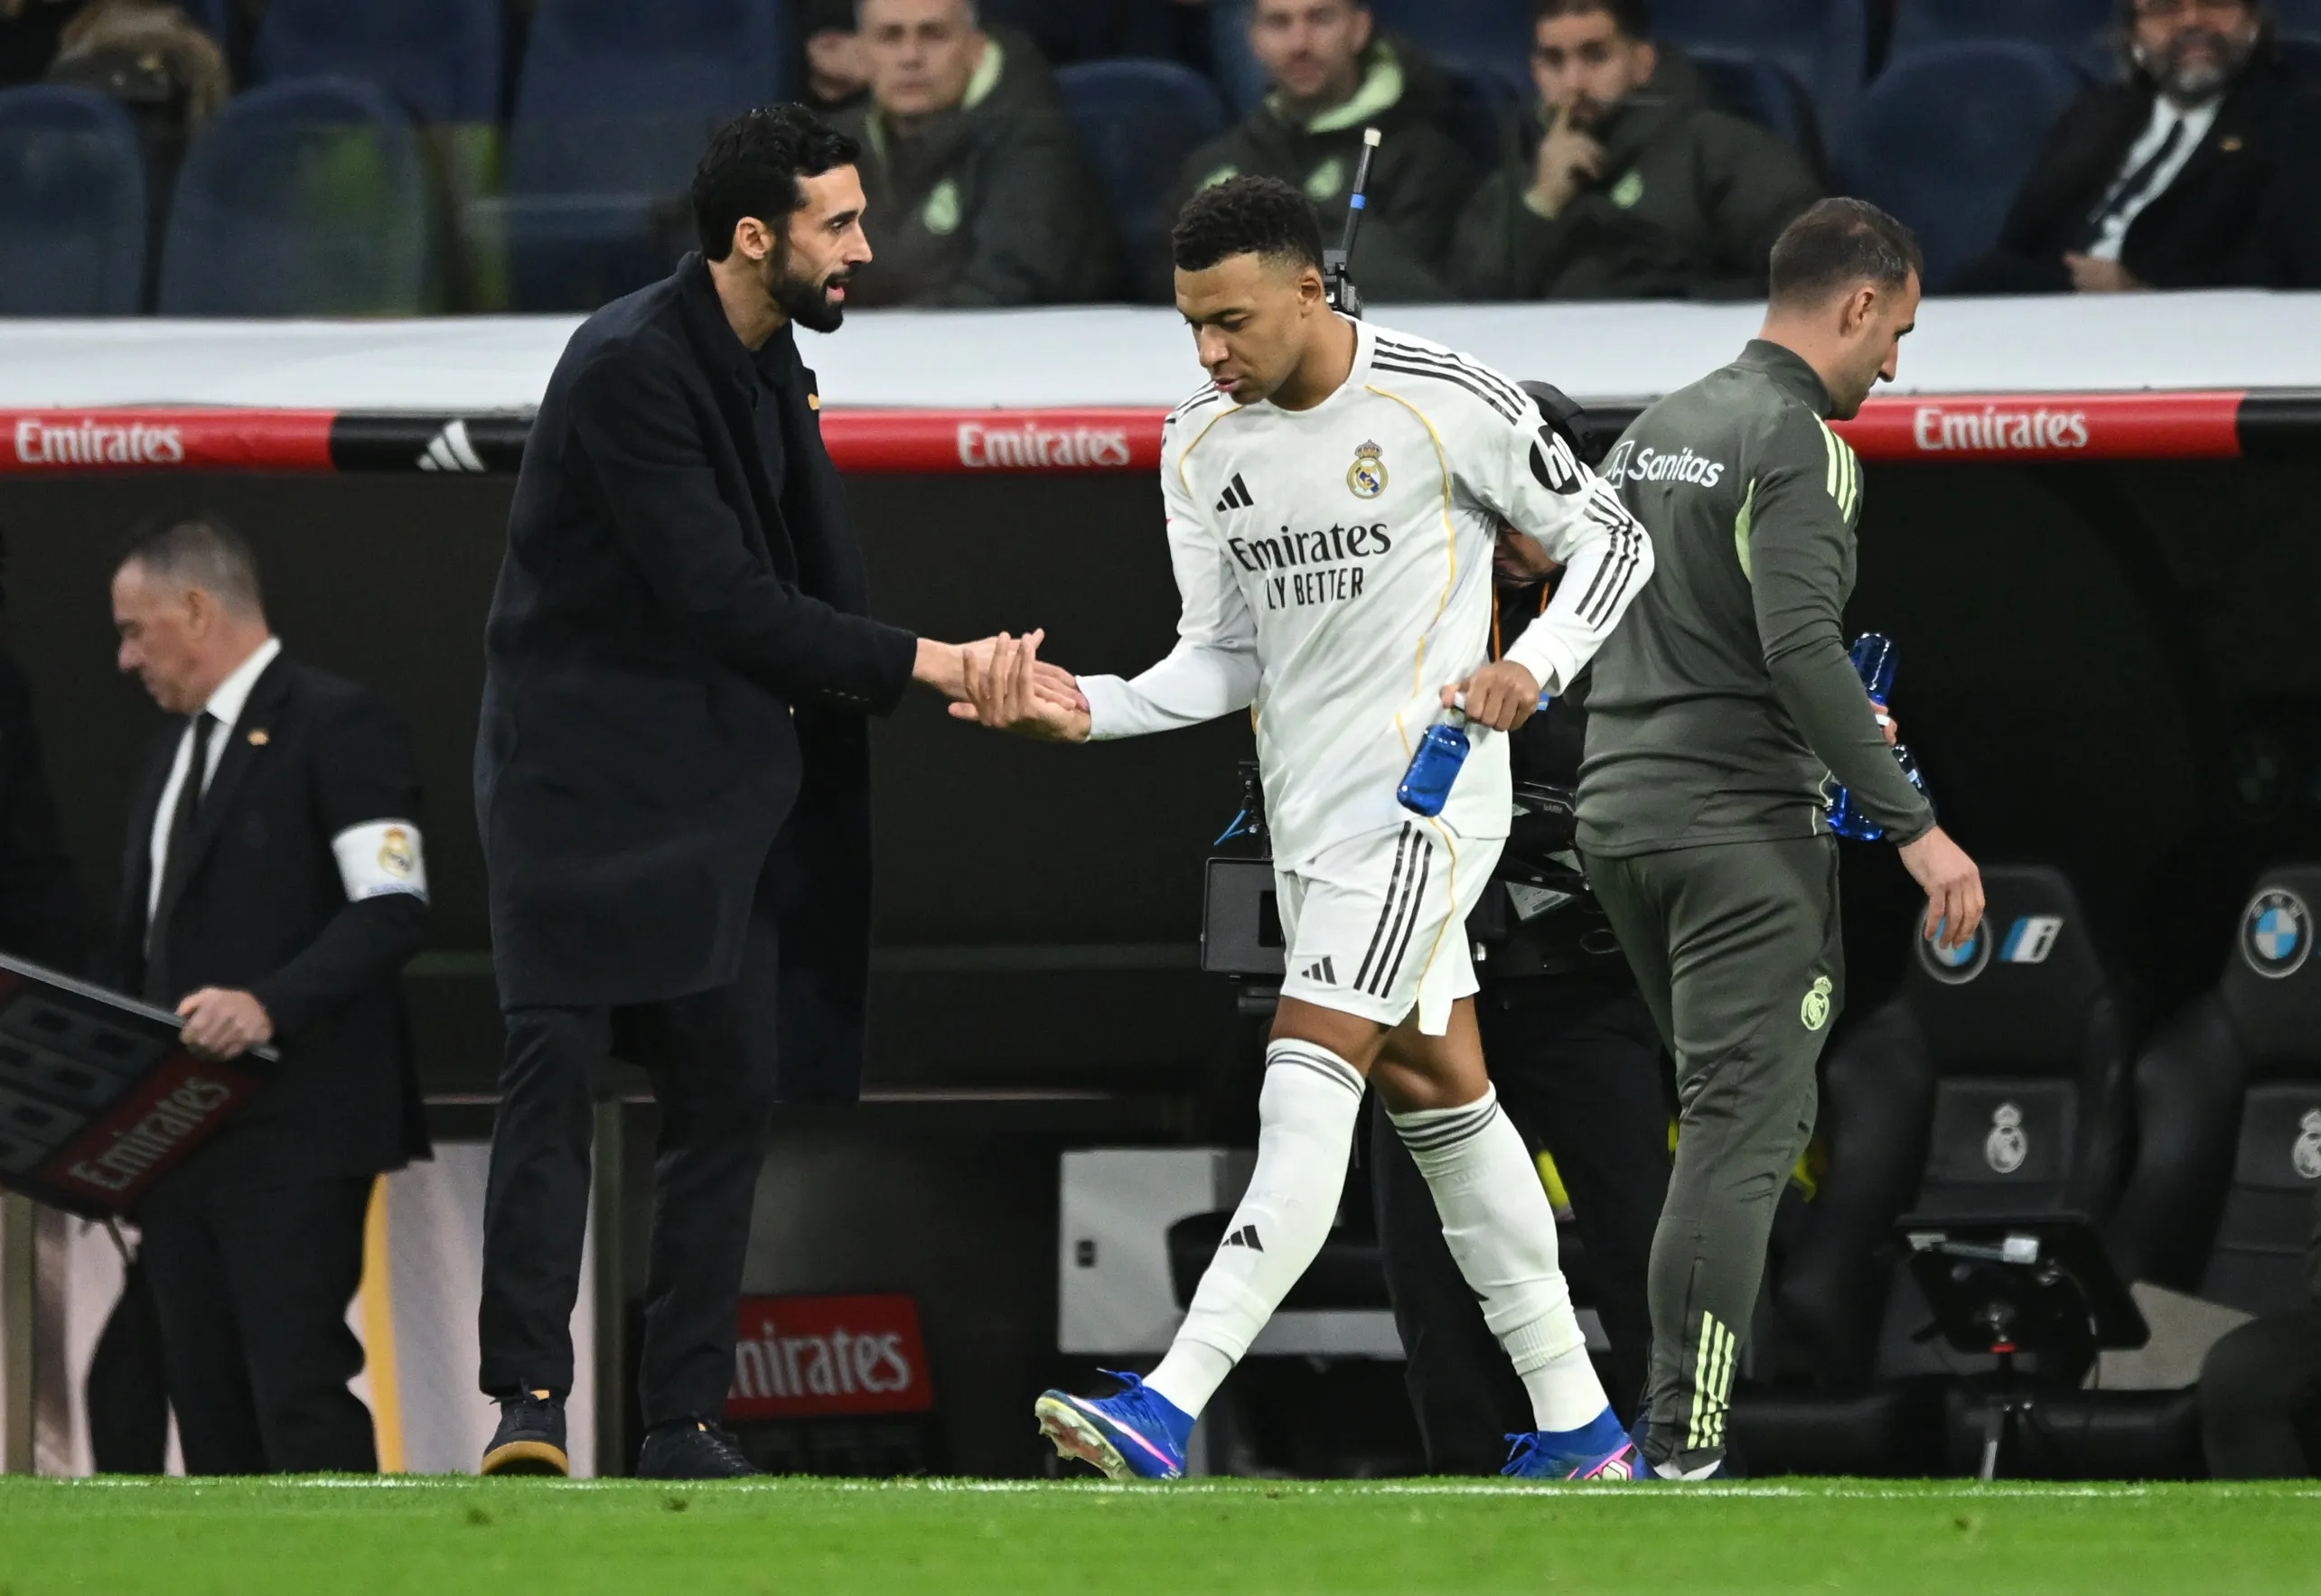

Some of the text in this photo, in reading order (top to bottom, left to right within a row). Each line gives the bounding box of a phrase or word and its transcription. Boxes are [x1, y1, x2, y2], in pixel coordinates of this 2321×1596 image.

[15, 418, 184, 463] Emirates
[958, 422, 1130, 466] Emirates
[1915, 406, 2089, 450] Emirates
[1628, 446, 1725, 488] Sanitas
[1228, 522, 1391, 571] Emirates
[1294, 566, 1364, 605] BETTER
[69, 1077, 230, 1190] Emirates
[726, 1319, 911, 1399] mirates
